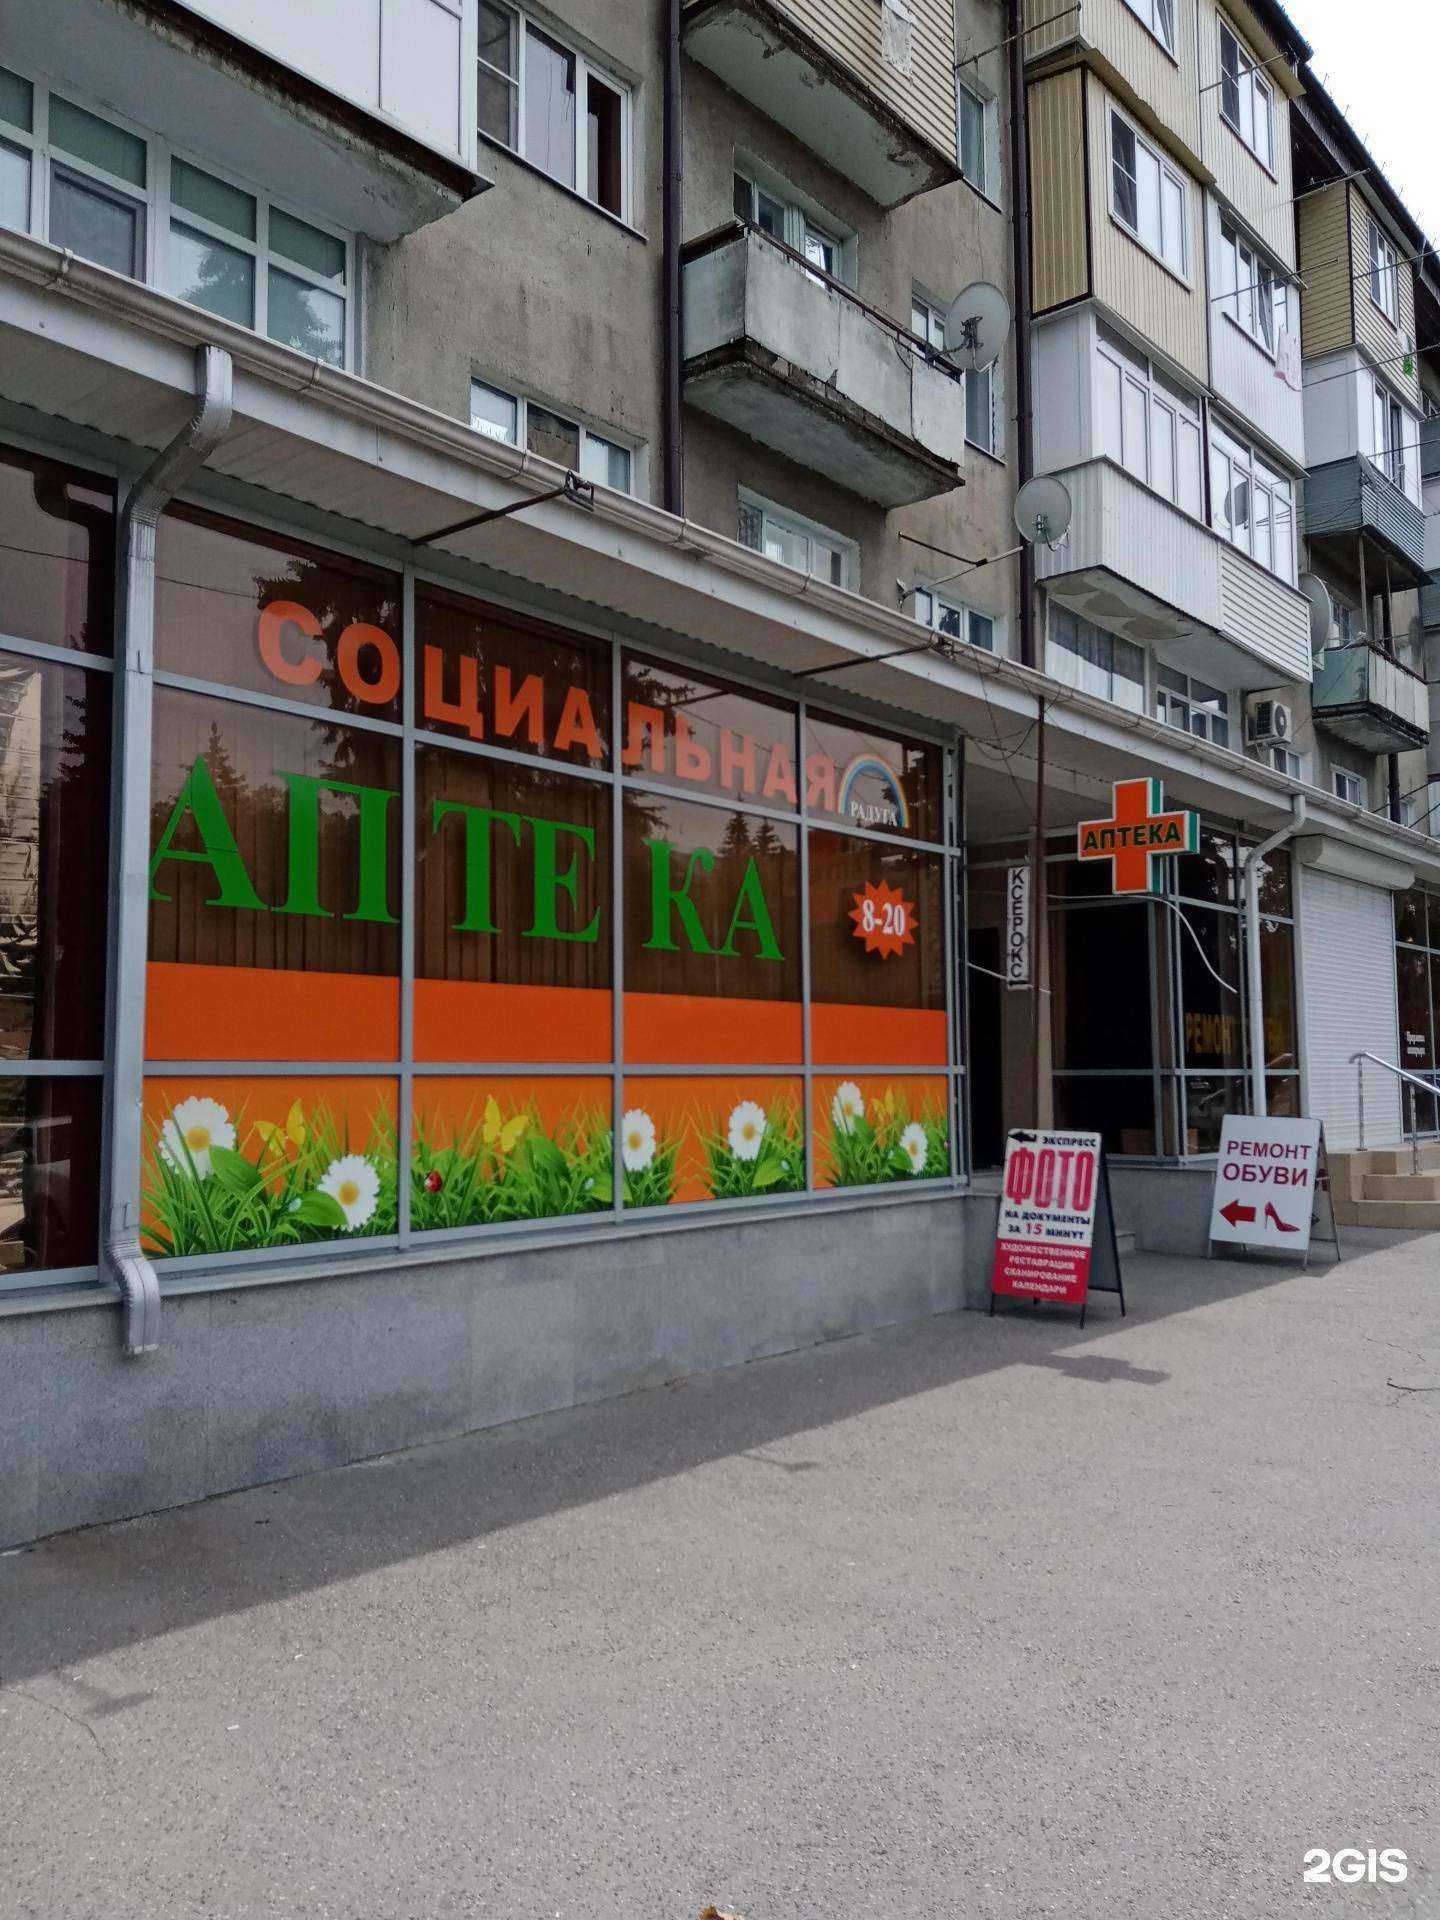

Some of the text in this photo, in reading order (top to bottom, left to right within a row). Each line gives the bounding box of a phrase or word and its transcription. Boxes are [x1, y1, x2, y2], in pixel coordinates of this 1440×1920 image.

[256, 598, 836, 812] СОЦИАЛЬНАЯ
[850, 800, 898, 827] РАДУГА
[1083, 821, 1181, 850] АПТЕКА
[150, 756, 785, 961] АПТЕКА
[862, 898, 906, 937] 8-20
[1010, 868, 1025, 979] КСЕРОКС
[1042, 1136, 1097, 1147] ЭКСПРЕСС
[1226, 1140, 1312, 1160] РЕМОНТ
[1006, 1147, 1094, 1211] ФОТО
[1223, 1162, 1308, 1187] ОБУВИ
[1005, 1210, 1091, 1225] НА ДОКУМЕНТЫ
[1008, 1222, 1084, 1239] ЗА 15 МИНУТ
[1003, 1267, 1078, 1284] СКАНИРОВАНИЕ
[1008, 1255, 1075, 1270] РЕСТАВРАЦИЯ
